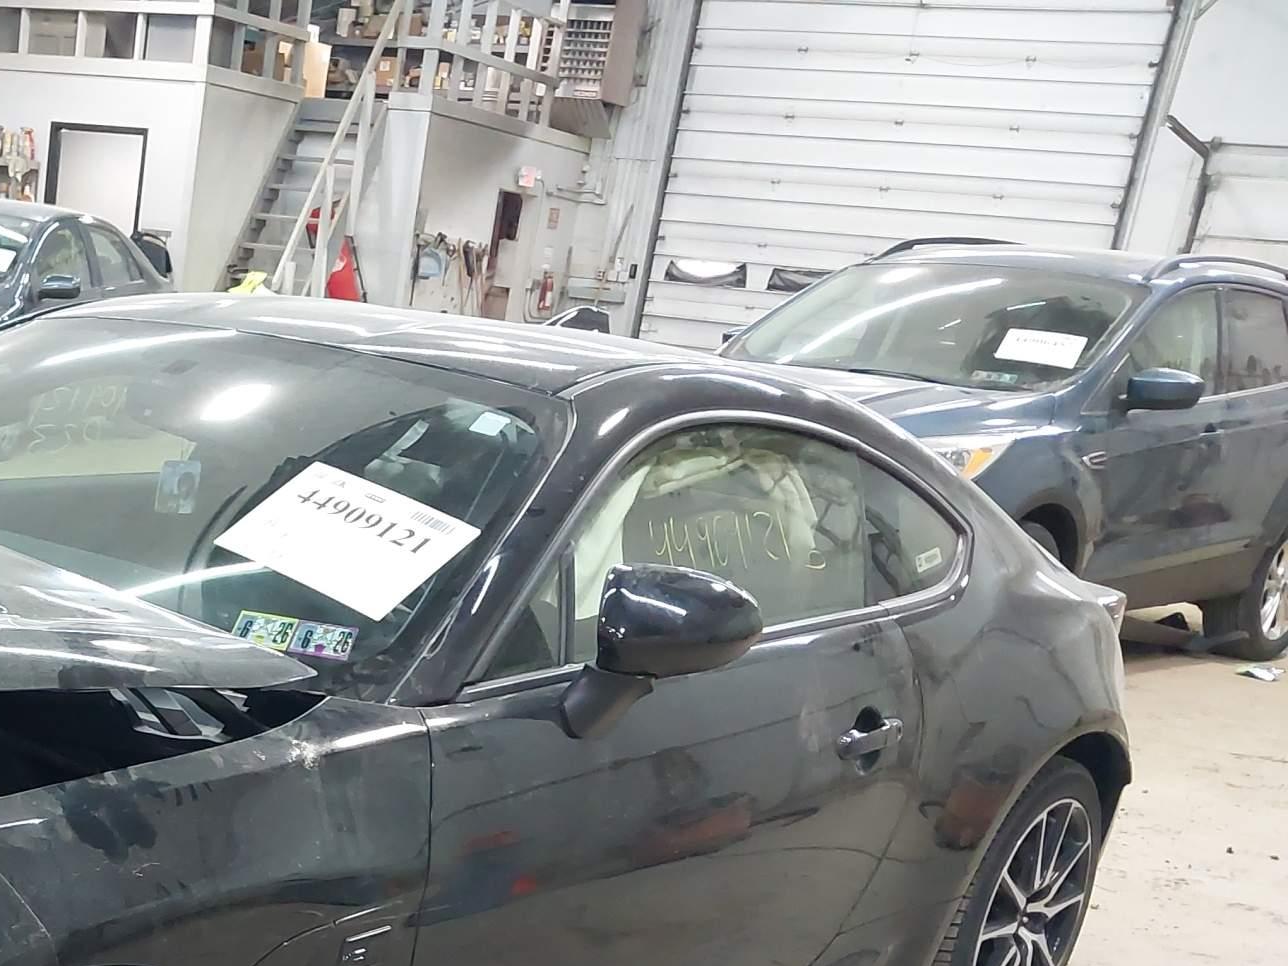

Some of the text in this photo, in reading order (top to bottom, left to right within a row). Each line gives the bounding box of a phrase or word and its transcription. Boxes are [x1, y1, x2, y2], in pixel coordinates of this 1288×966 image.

[297, 489, 431, 554] 44909121
[239, 620, 293, 645] 6 26
[301, 629, 353, 653] 6 26
